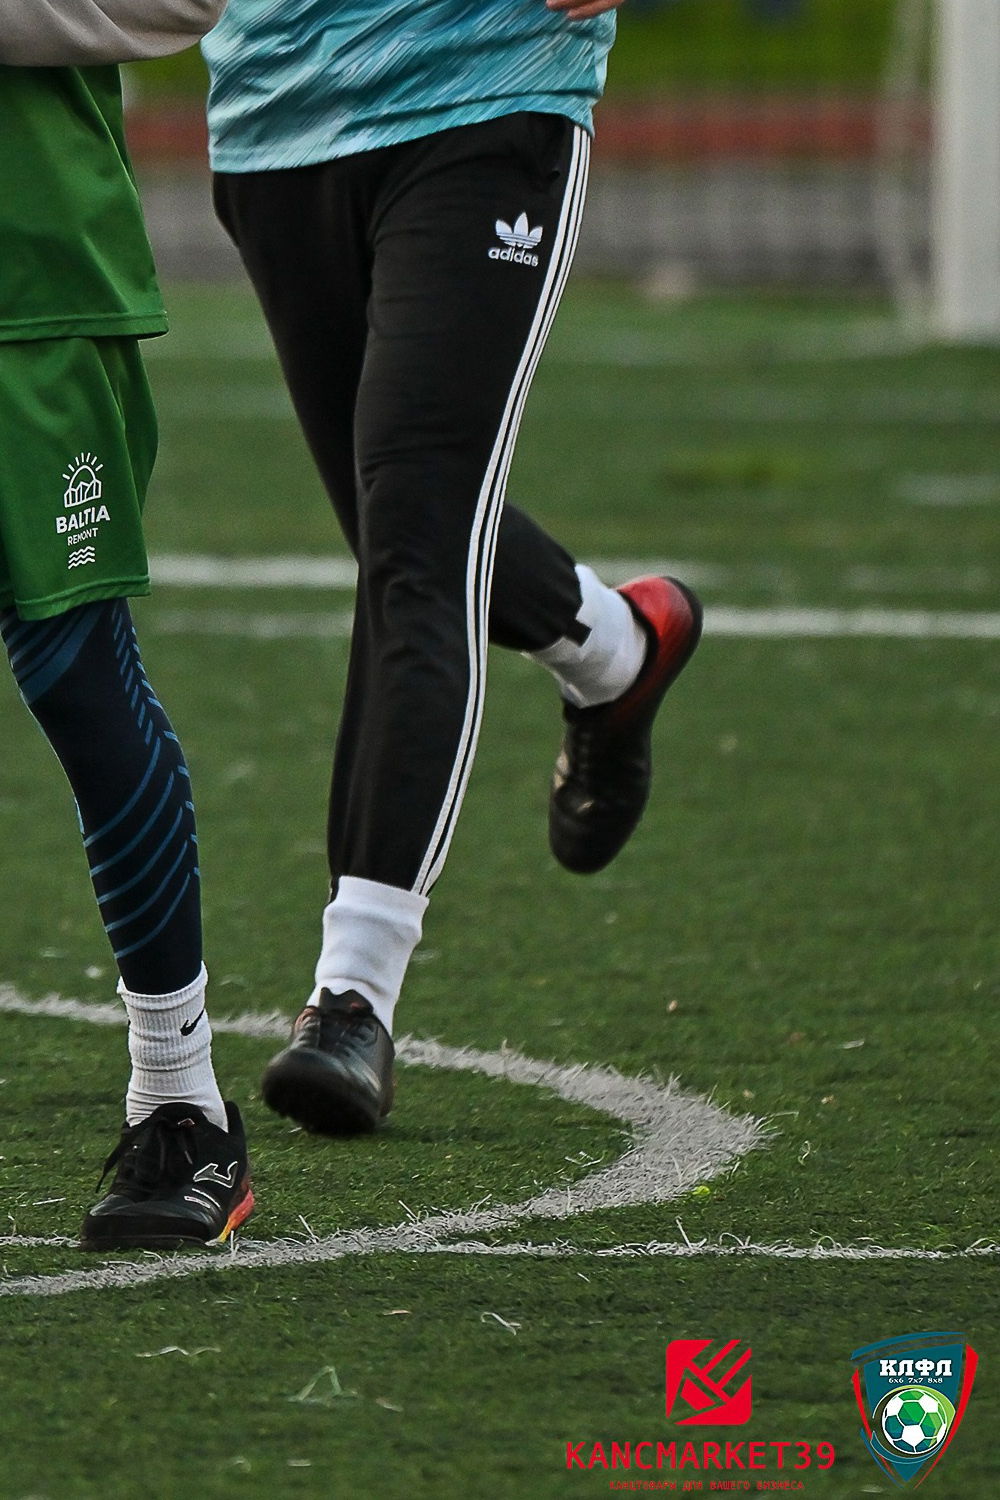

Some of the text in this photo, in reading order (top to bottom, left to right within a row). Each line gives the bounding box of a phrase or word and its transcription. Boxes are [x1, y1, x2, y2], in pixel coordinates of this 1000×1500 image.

[488, 247, 539, 267] adidas
[55, 505, 111, 534] BALTIA
[67, 527, 99, 546] REMONT
